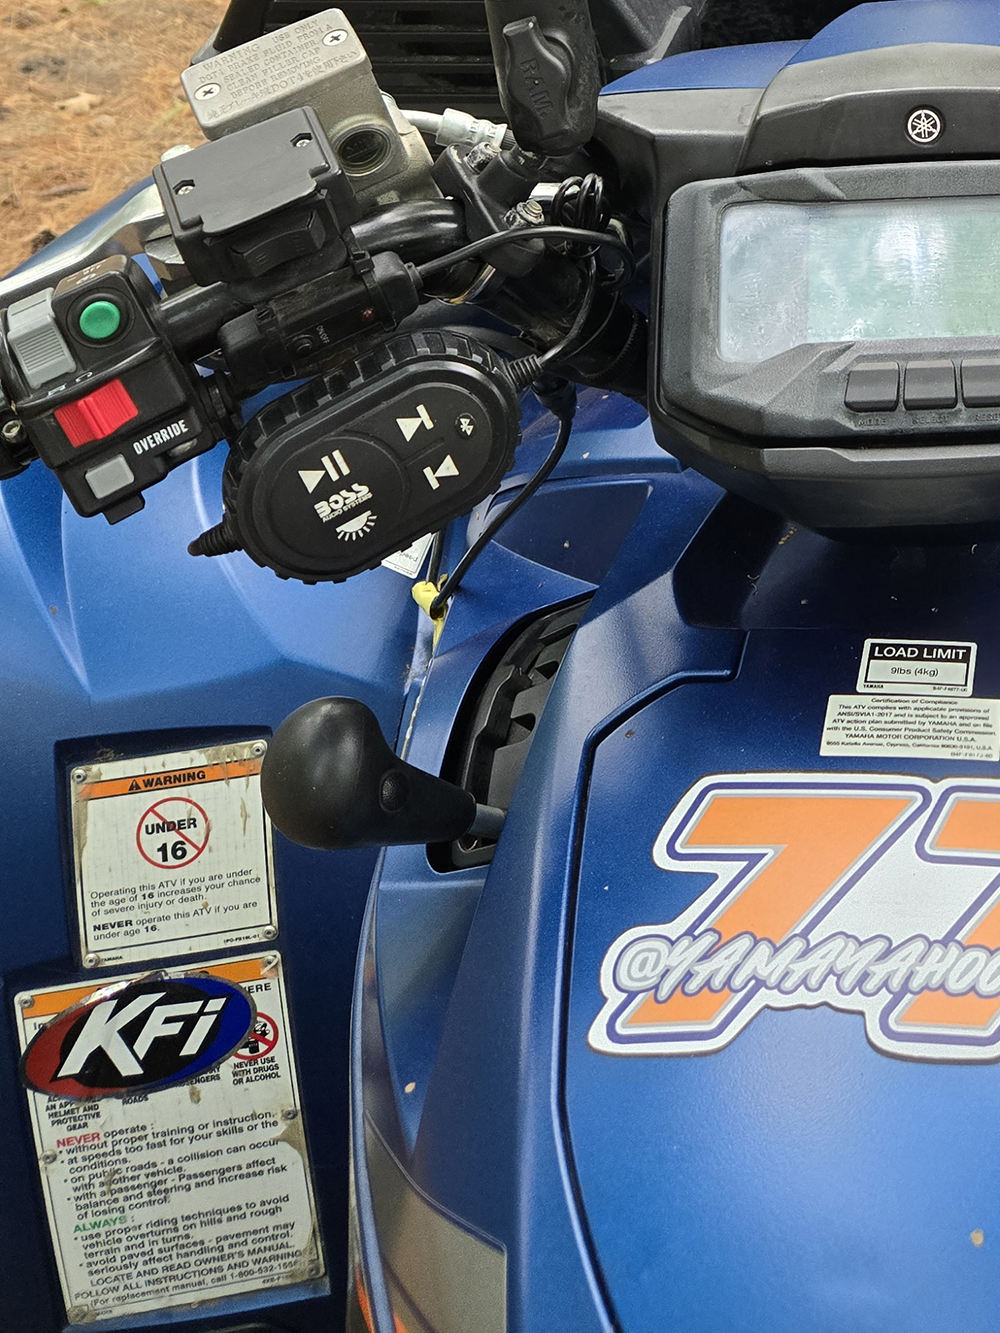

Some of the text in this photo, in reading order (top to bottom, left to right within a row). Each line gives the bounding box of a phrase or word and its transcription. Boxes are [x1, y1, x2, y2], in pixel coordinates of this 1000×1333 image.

[202, 18, 319, 73] WARNING USE ONLY
[227, 52, 260, 71] BRAKE
[261, 39, 293, 57] FLUID
[296, 26, 324, 42] FROM
[222, 38, 317, 84] SEALED CONTAINER
[225, 46, 322, 92] CLEAN FILLER CAP
[230, 78, 268, 99] BEFORE
[133, 419, 188, 455] OVERRIDE
[314, 483, 370, 518] BOSS
[322, 492, 373, 523] AUDIO SYSTEMS
[874, 646, 966, 659] LOAD LIMIT
[890, 666, 938, 676] 9lbs (4kg)
[142, 769, 205, 789] WARNING
[144, 816, 197, 835] UNDER
[156, 839, 187, 863] 16
[90, 885, 136, 900] Operating
[139, 882, 155, 891] this
[157, 879, 177, 889] ATV
[188, 876, 205, 886] you
[208, 873, 223, 881] are
[226, 867, 252, 878] under
[90, 875, 260, 908] the age of 16 increases your chance
[91, 908, 100, 916] of
[103, 904, 134, 915] severe
[137, 899, 163, 911] injury
[177, 892, 206, 903] death.
[92, 919, 132, 931] NEVER
[135, 914, 171, 926] operate
[173, 910, 190, 919] this
[192, 907, 211, 916] ATV
[214, 905, 220, 913] if
[223, 904, 239, 913] you
[93, 924, 159, 940] under age 16.
[231, 1063, 279, 1077] WITH DRUGS
[233, 1056, 275, 1069] NEVER USE
[232, 1071, 280, 1085] OR ALCOHOL
[47, 1103, 99, 1118] HELMET AND
[50, 1111, 101, 1126] PROTECTIVE
[56, 1124, 147, 1148] NEVER operate
[65, 1109, 274, 1154] without proper training or instruction.
[66, 1122, 88, 1131] GEAR
[67, 1118, 278, 1165] at speeds too fast for your skills or the
[68, 1155, 131, 1174] conditions.
[72, 1215, 127, 1233] ALWAYS
[89, 1240, 294, 1287] LOCATE AND READ OWNER'S MANUAL.
[74, 1284, 120, 1300] FOLLOW
[121, 1280, 142, 1291] ALL
[144, 1264, 224, 1287] INSTRUCTIONS
[226, 1259, 249, 1271] AND
